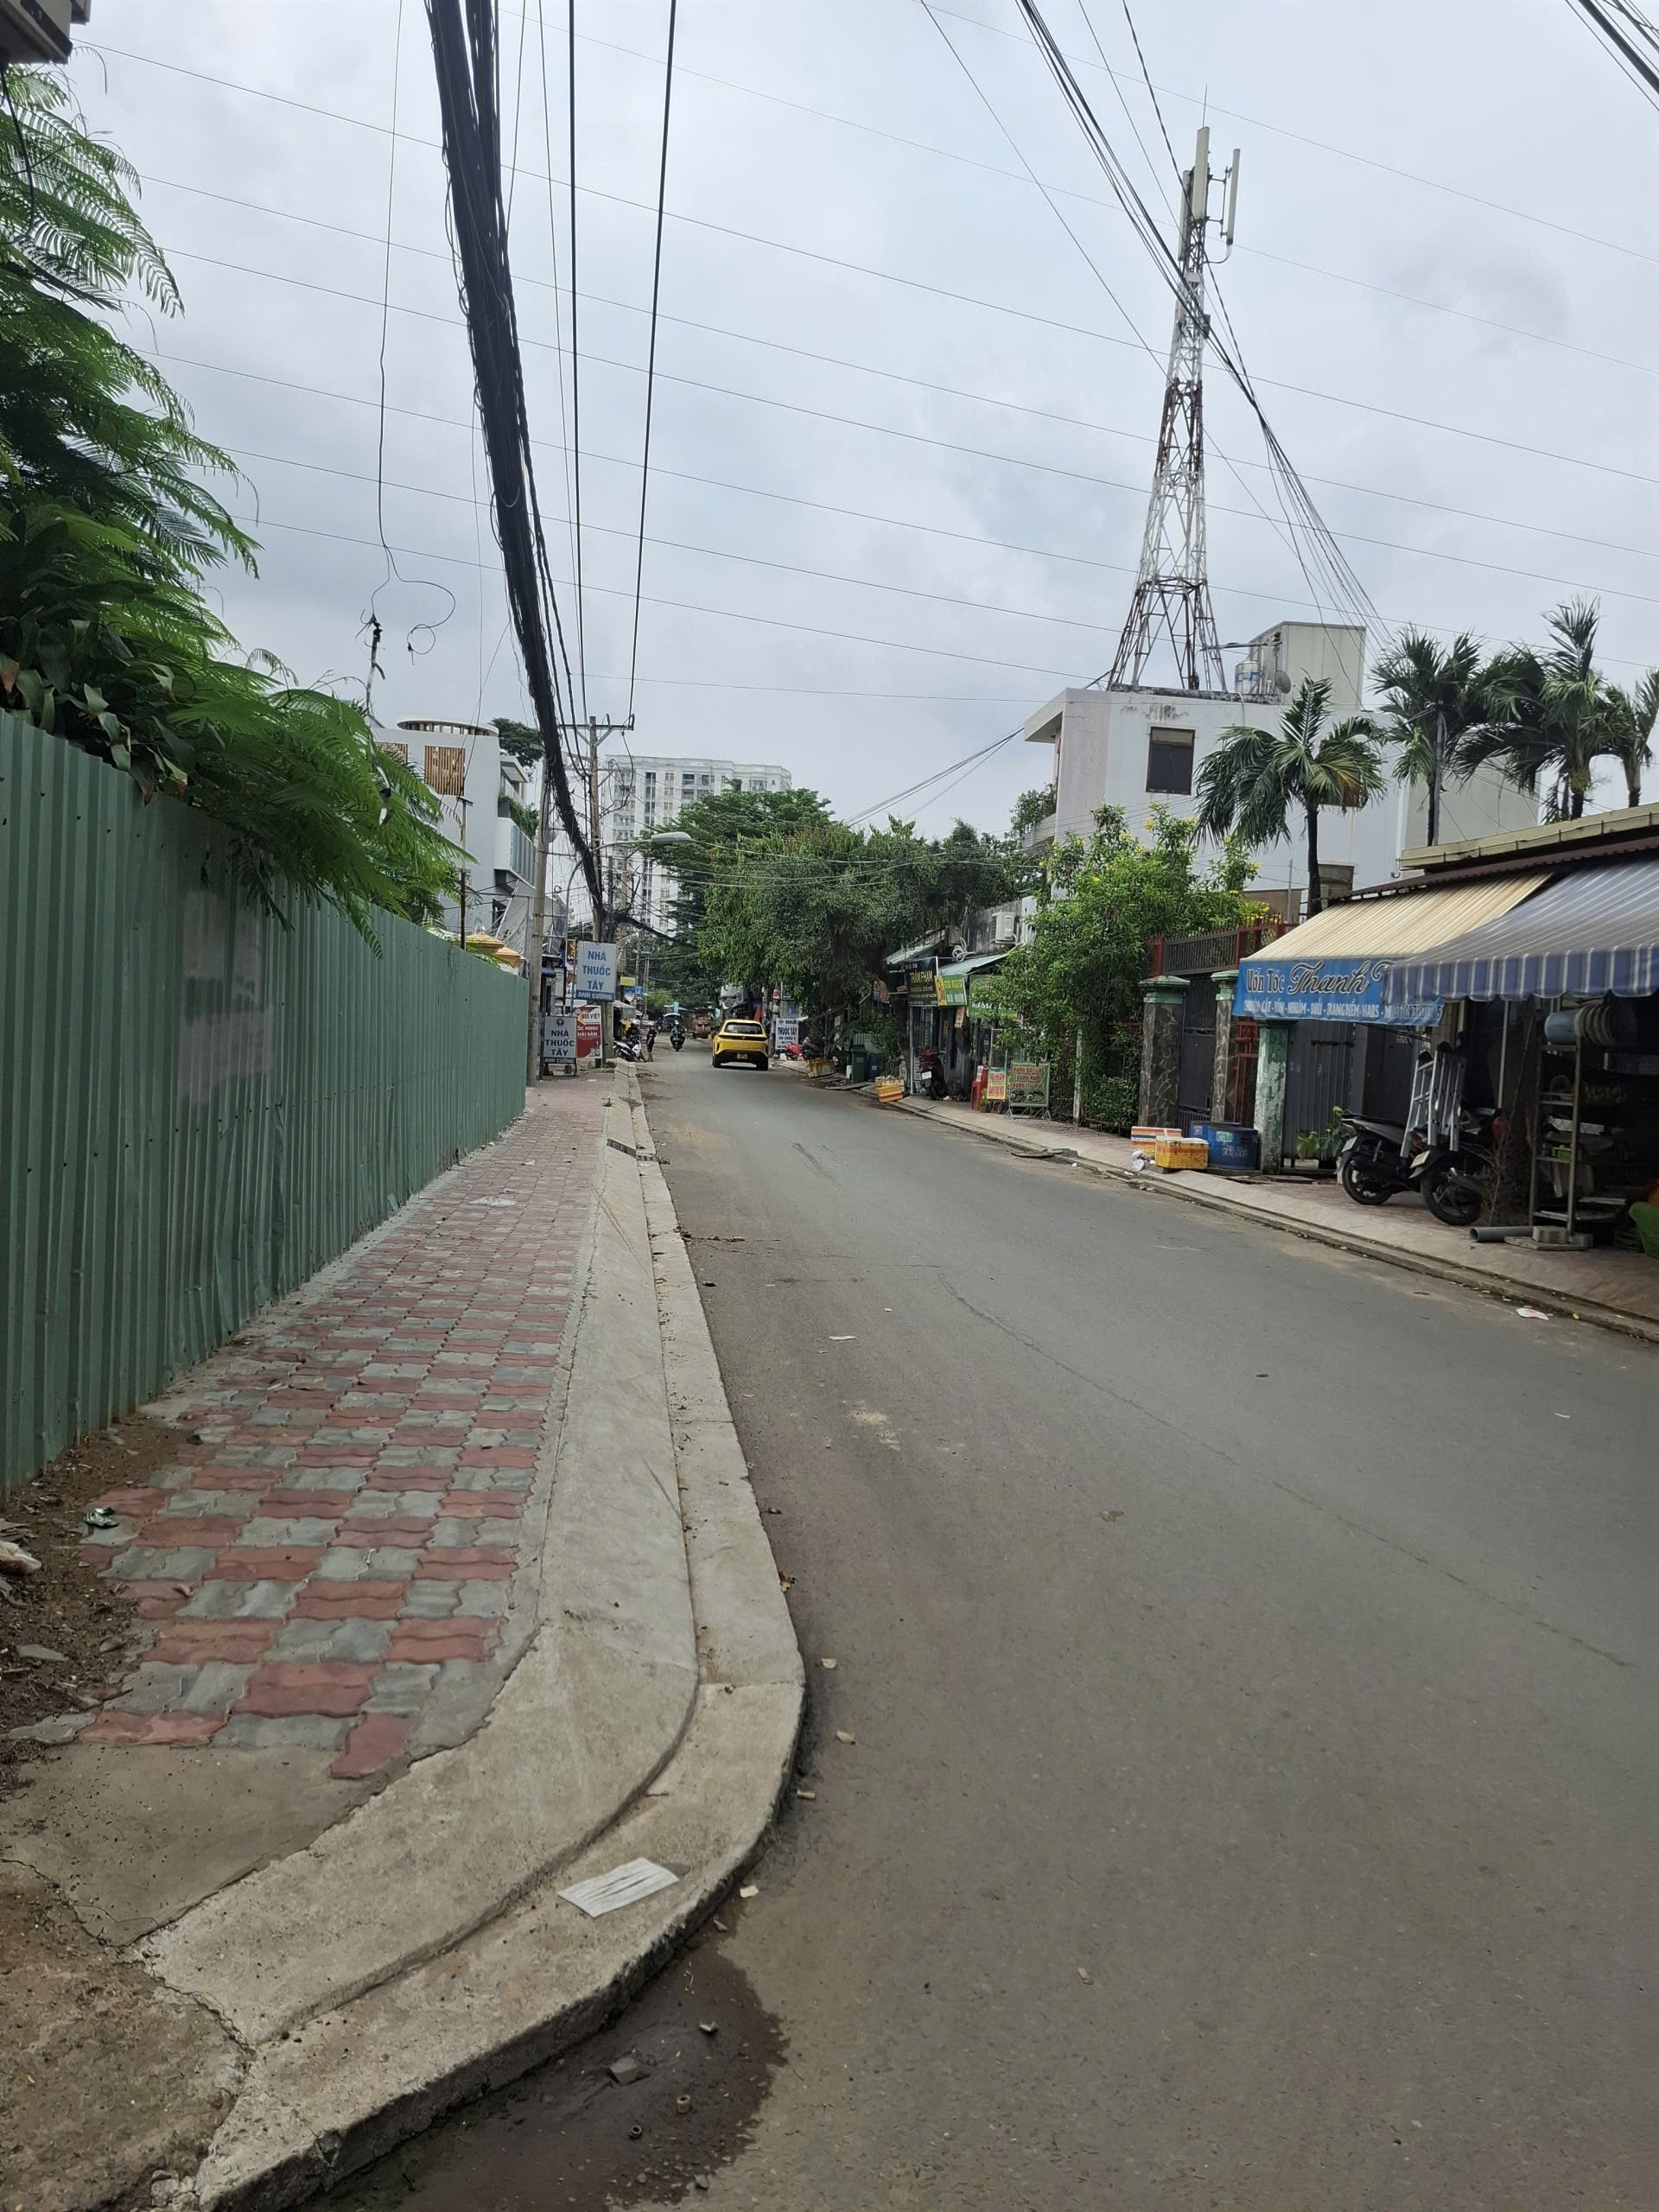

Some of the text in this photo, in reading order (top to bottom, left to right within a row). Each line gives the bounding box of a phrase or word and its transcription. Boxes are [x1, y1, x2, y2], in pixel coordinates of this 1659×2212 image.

[588, 950, 607, 961] NHÀ
[582, 964, 611, 976] THUỐC
[1267, 969, 1285, 993] Tóc
[1287, 960, 1370, 995] Thanh
[588, 979, 604, 990] TÂY
[545, 1038, 575, 1046] THUỐC
